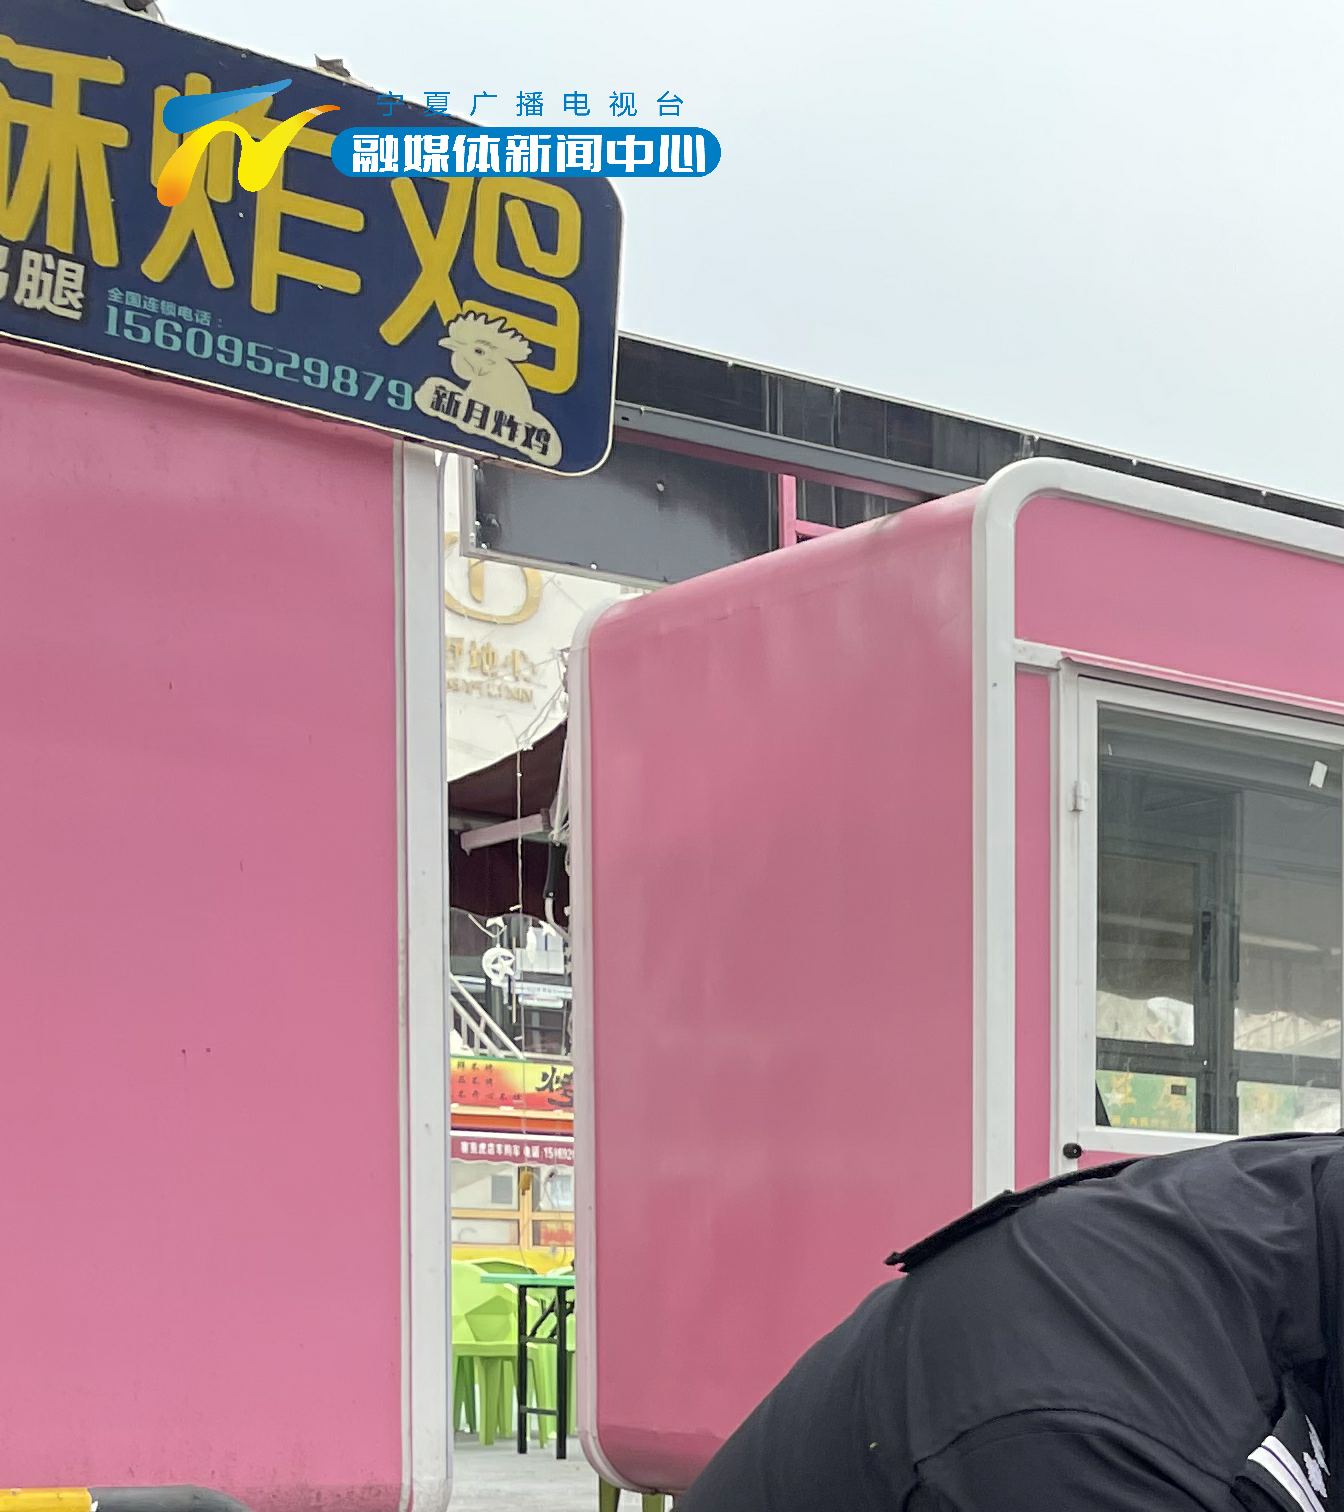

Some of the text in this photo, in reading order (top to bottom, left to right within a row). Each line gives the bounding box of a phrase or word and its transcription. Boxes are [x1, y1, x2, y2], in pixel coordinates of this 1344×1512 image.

[104, 304, 414, 411] 15609529879
[430, 383, 553, 458] 新月炸鸡
